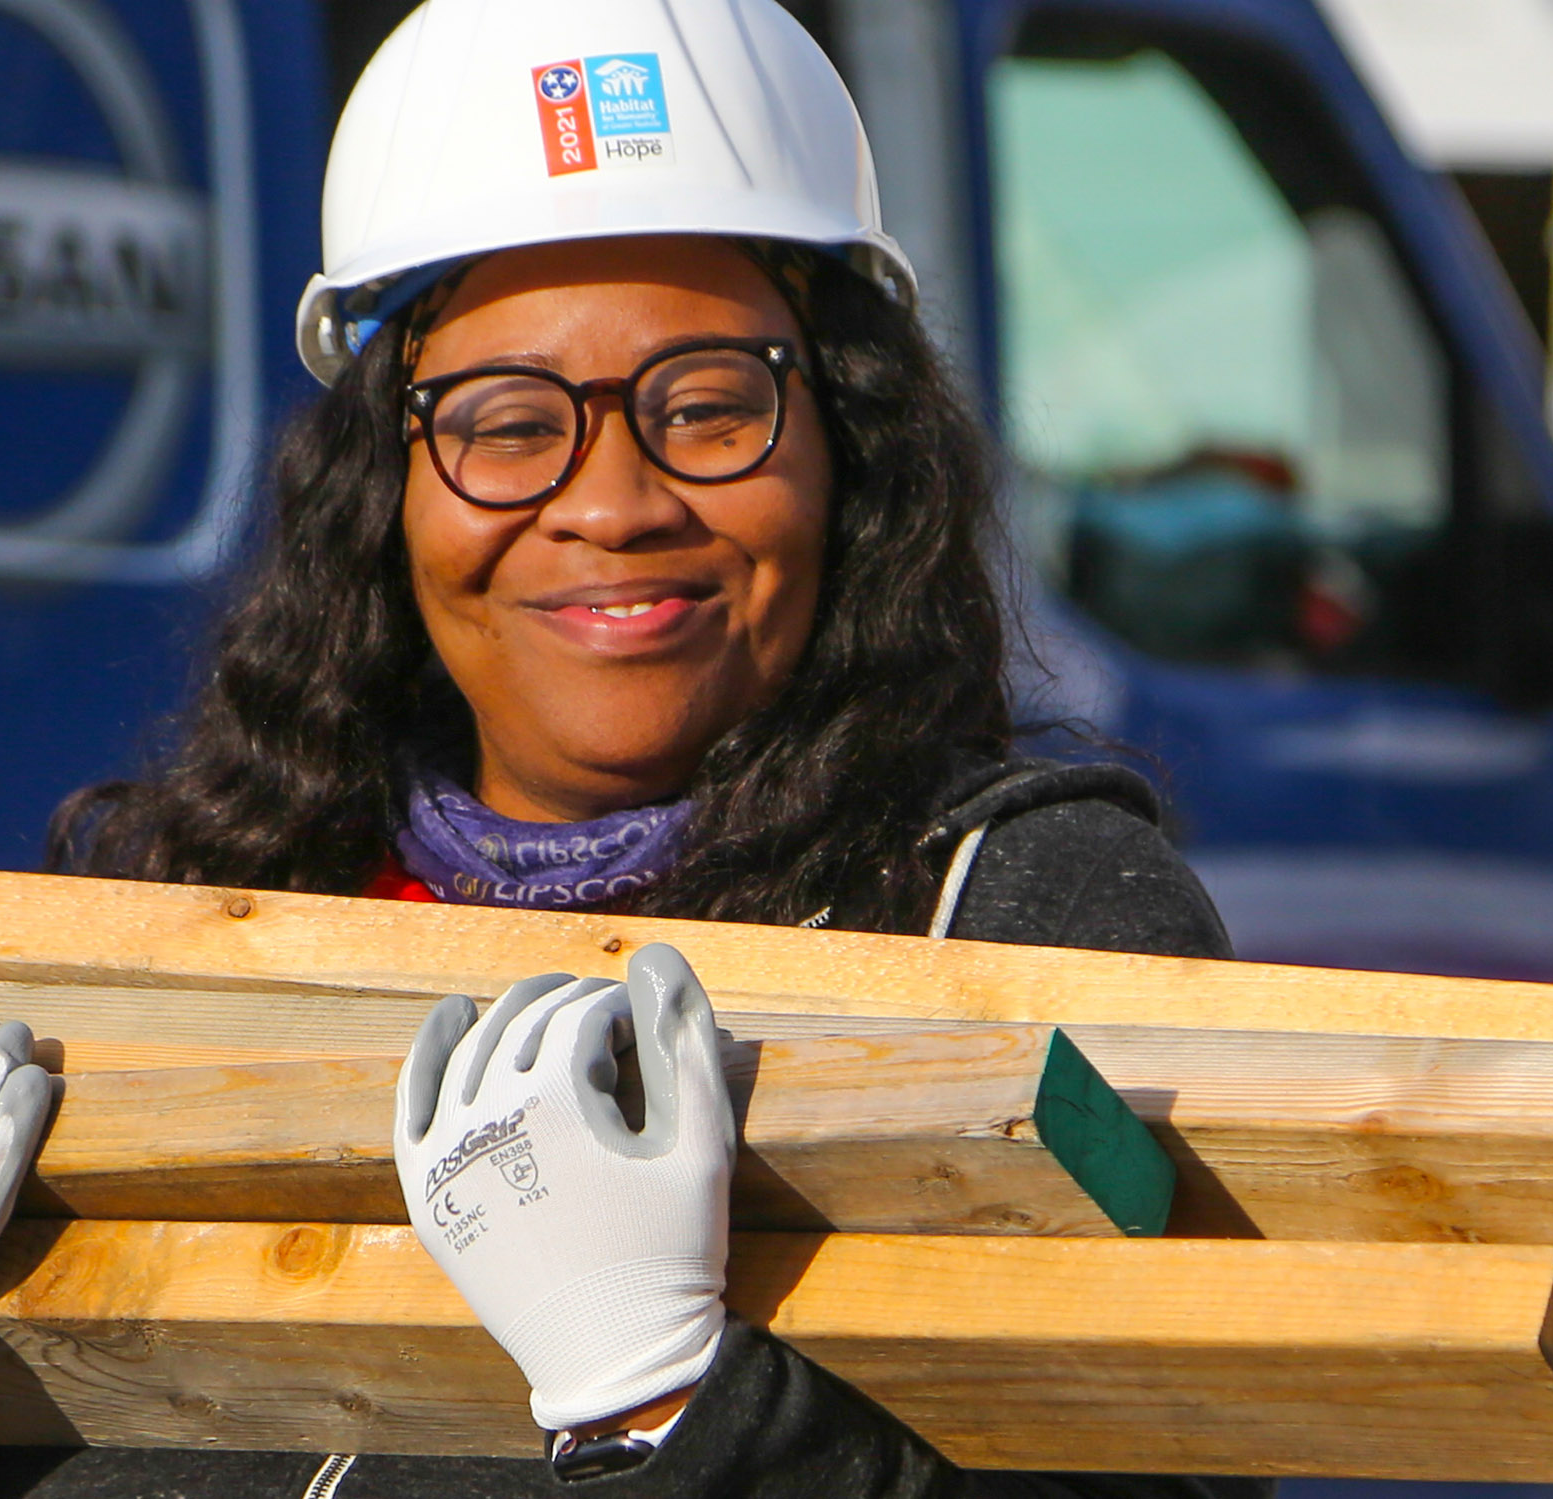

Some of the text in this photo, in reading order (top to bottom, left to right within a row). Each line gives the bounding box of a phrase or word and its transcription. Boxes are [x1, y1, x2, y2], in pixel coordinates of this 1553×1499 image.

[599, 98, 655, 114] Habitat
[555, 106, 582, 165] 2021
[605, 139, 663, 161] Hope
[490, 1139, 533, 1166] EN388
[518, 1186, 549, 1207] 4121
[454, 1223, 489, 1255] Size: L
